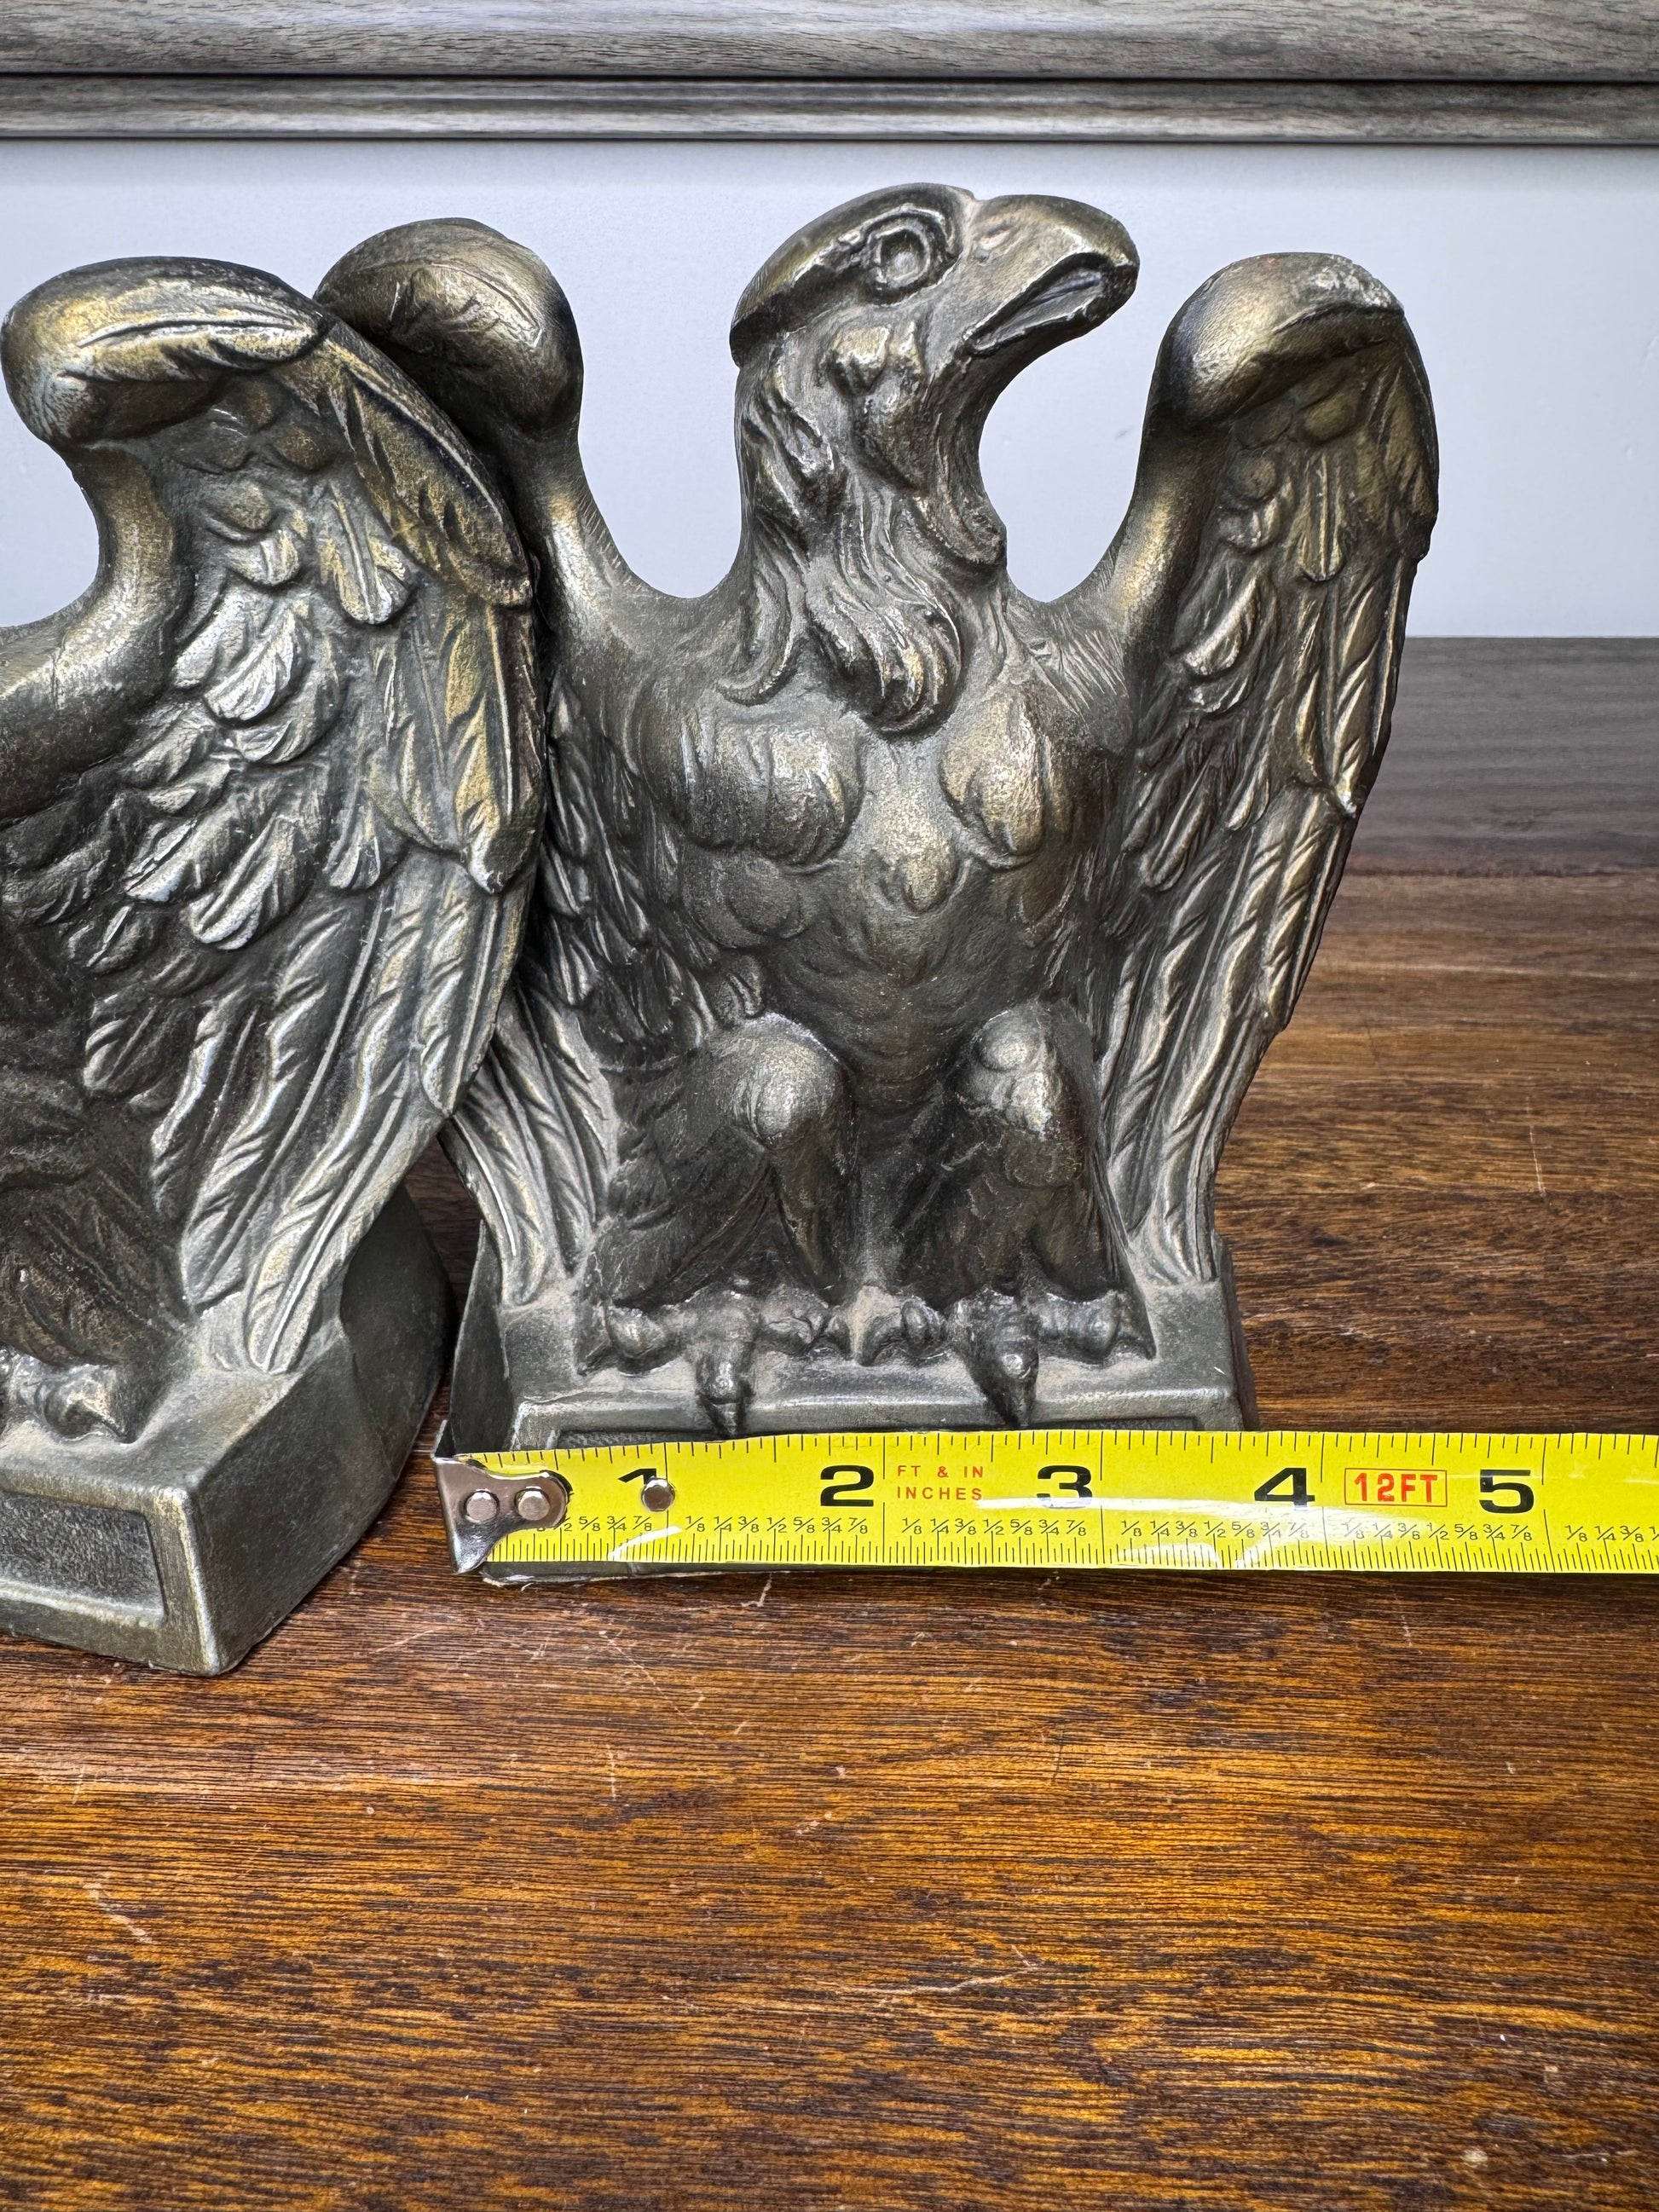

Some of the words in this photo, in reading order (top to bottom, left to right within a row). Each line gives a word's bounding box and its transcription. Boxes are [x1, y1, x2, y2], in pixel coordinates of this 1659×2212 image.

[820, 1464, 875, 1507] 2
[897, 1465, 922, 1477] FT
[937, 1465, 949, 1478] &
[964, 1466, 984, 1478] IN
[1036, 1465, 1093, 1509] 3
[1254, 1467, 1315, 1511] 4
[1354, 1472, 1438, 1503] 12FT
[897, 1487, 983, 1501] INCHES
[1479, 1469, 1535, 1514] 5
[579, 1516, 601, 1532] 5/8
[607, 1516, 627, 1532] 3/4
[634, 1516, 652, 1532] 7/8
[685, 1516, 705, 1533] 1/8
[714, 1516, 732, 1533] 1/4
[738, 1516, 760, 1533] 3/8
[766, 1517, 787, 1533] 1/2
[793, 1517, 815, 1533] 5/8
[821, 1517, 842, 1533] 3/4
[848, 1517, 868, 1533] 7/8
[902, 1518, 922, 1535] 1/8
[930, 1519, 950, 1535] 1/4
[955, 1518, 976, 1535] 3/8
[983, 1519, 1004, 1536] 1/2
[1009, 1518, 1032, 1535] 5/8
[1038, 1519, 1059, 1536] 3/4
[1066, 1520, 1087, 1536] 7/8
[1121, 1520, 1142, 1537] 1/8
[1150, 1521, 1170, 1537] 1/4
[1176, 1520, 1198, 1538] 3/8
[1204, 1521, 1226, 1539] 1/2
[1232, 1521, 1255, 1539] 5/8
[1426, 1522, 1449, 1540] 1/2
[1454, 1523, 1478, 1540] 5/8
[1483, 1524, 1505, 1540] 3/4
[1511, 1524, 1532, 1541] 7/8
[1565, 1525, 1587, 1542] 1/8
[1594, 1526, 1616, 1541] 1/4
[1620, 1525, 1644, 1542] 3/8
